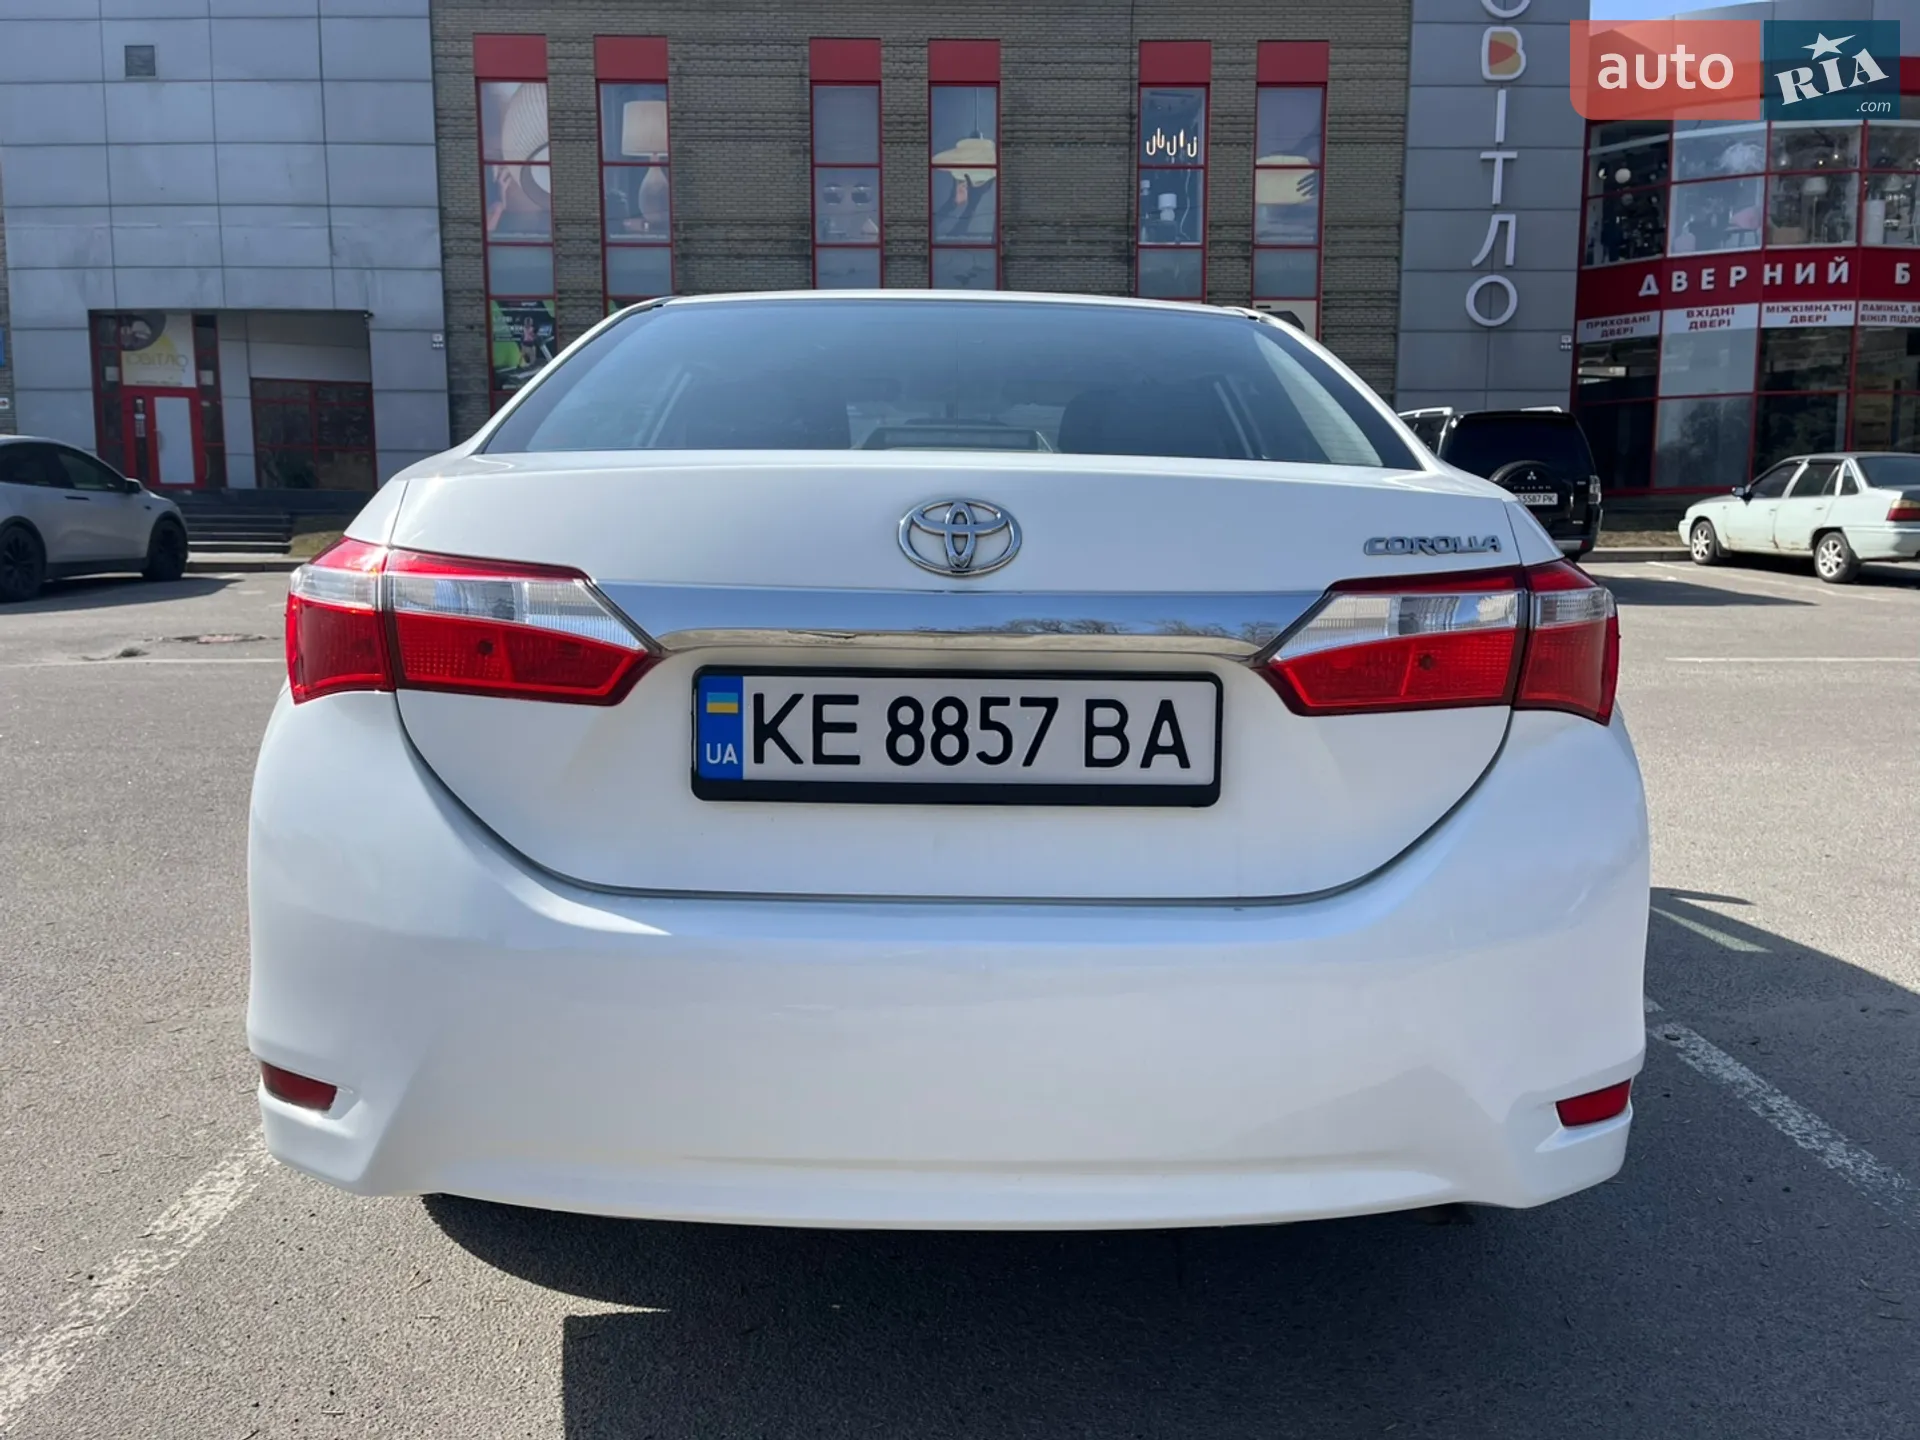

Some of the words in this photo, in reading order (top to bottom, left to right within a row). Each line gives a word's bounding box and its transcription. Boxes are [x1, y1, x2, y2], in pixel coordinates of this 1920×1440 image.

[1638, 255, 1850, 297] ДВЕРНИЙ
[1686, 307, 1735, 318] ВХІДНІ
[1766, 304, 1852, 313] МІЖКІМНАТНІ
[1586, 315, 1651, 329] ПРИХОВАНІ
[1688, 319, 1731, 330] ДВЕРІ
[1789, 315, 1827, 324] ДВЕРІ
[1600, 327, 1634, 338] ДВЕРІ
[1363, 535, 1503, 556] COROLLA
[751, 692, 861, 766] KE
[885, 695, 1059, 768] 8857
[1084, 698, 1192, 770] BA
[705, 743, 739, 765] UA
